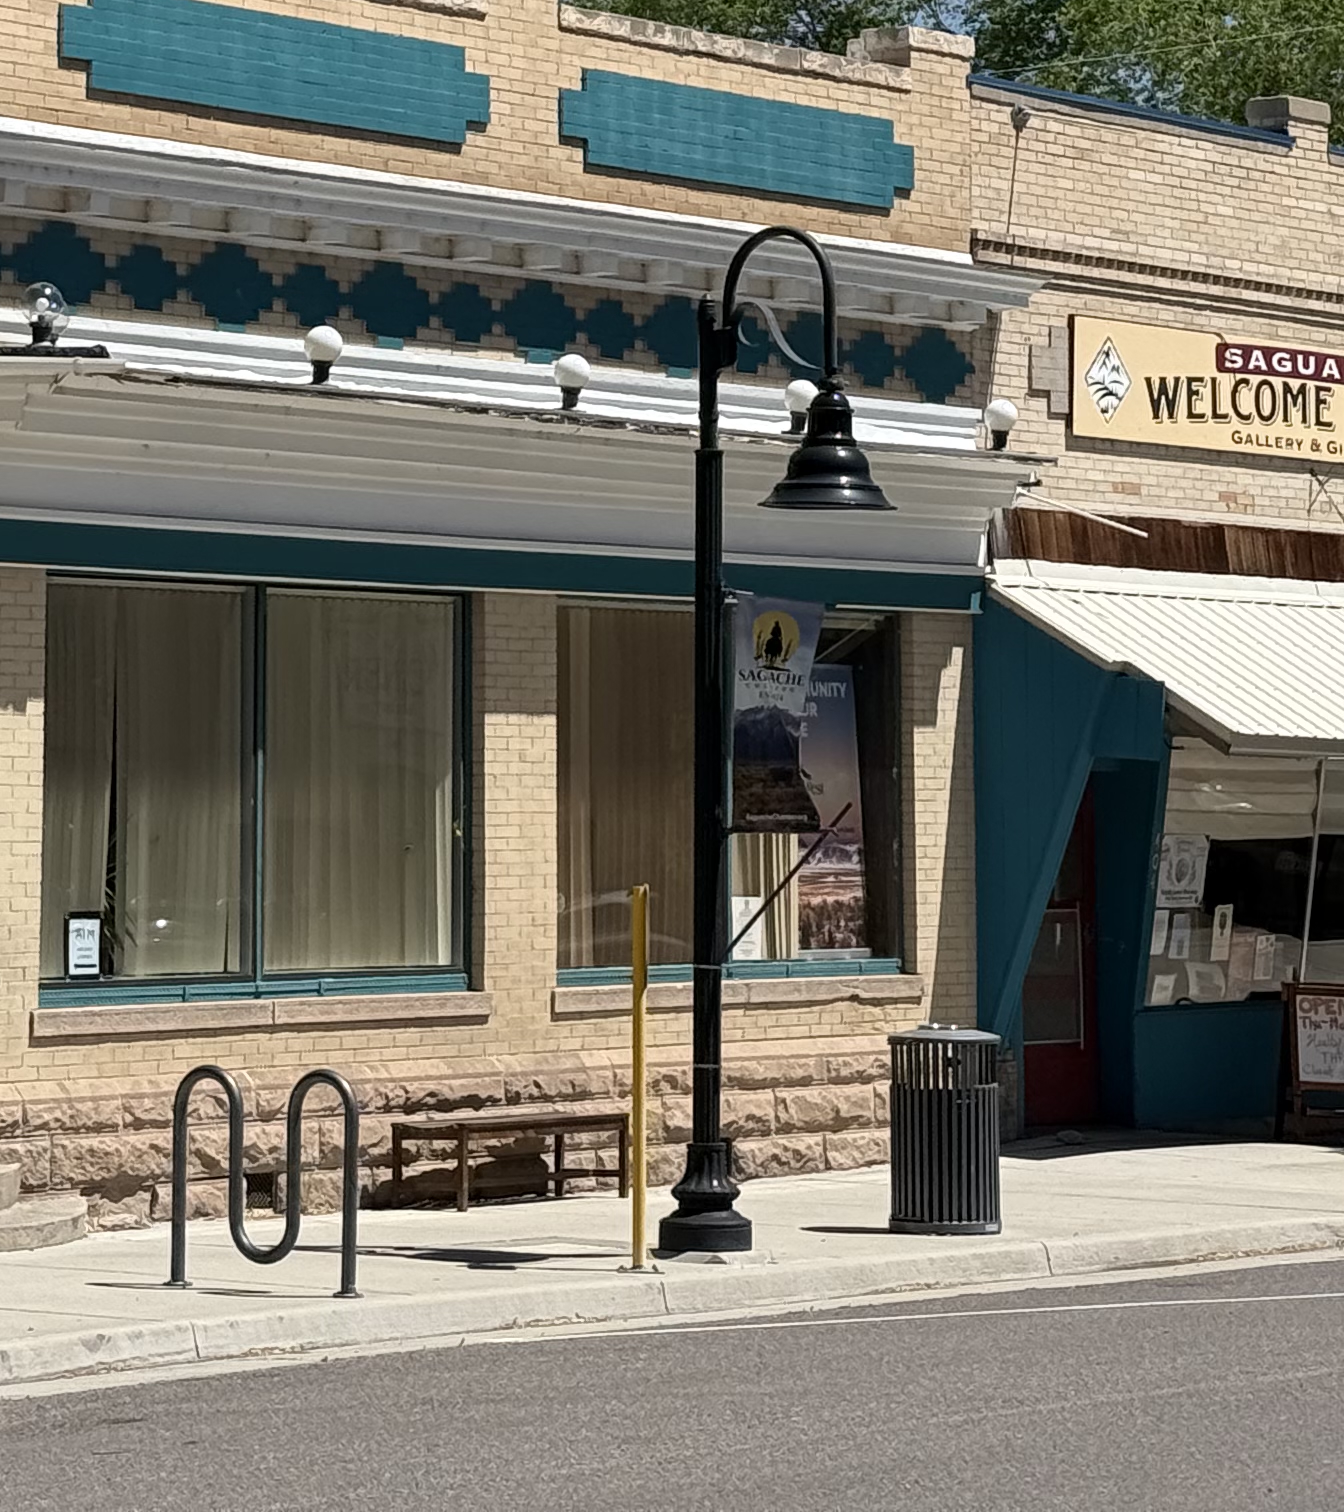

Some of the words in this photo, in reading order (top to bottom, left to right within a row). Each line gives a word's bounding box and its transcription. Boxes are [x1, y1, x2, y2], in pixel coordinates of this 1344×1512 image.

[1143, 374, 1337, 431] WELCOME
[1231, 430, 1304, 452] GALLERY
[1310, 438, 1323, 453] &
